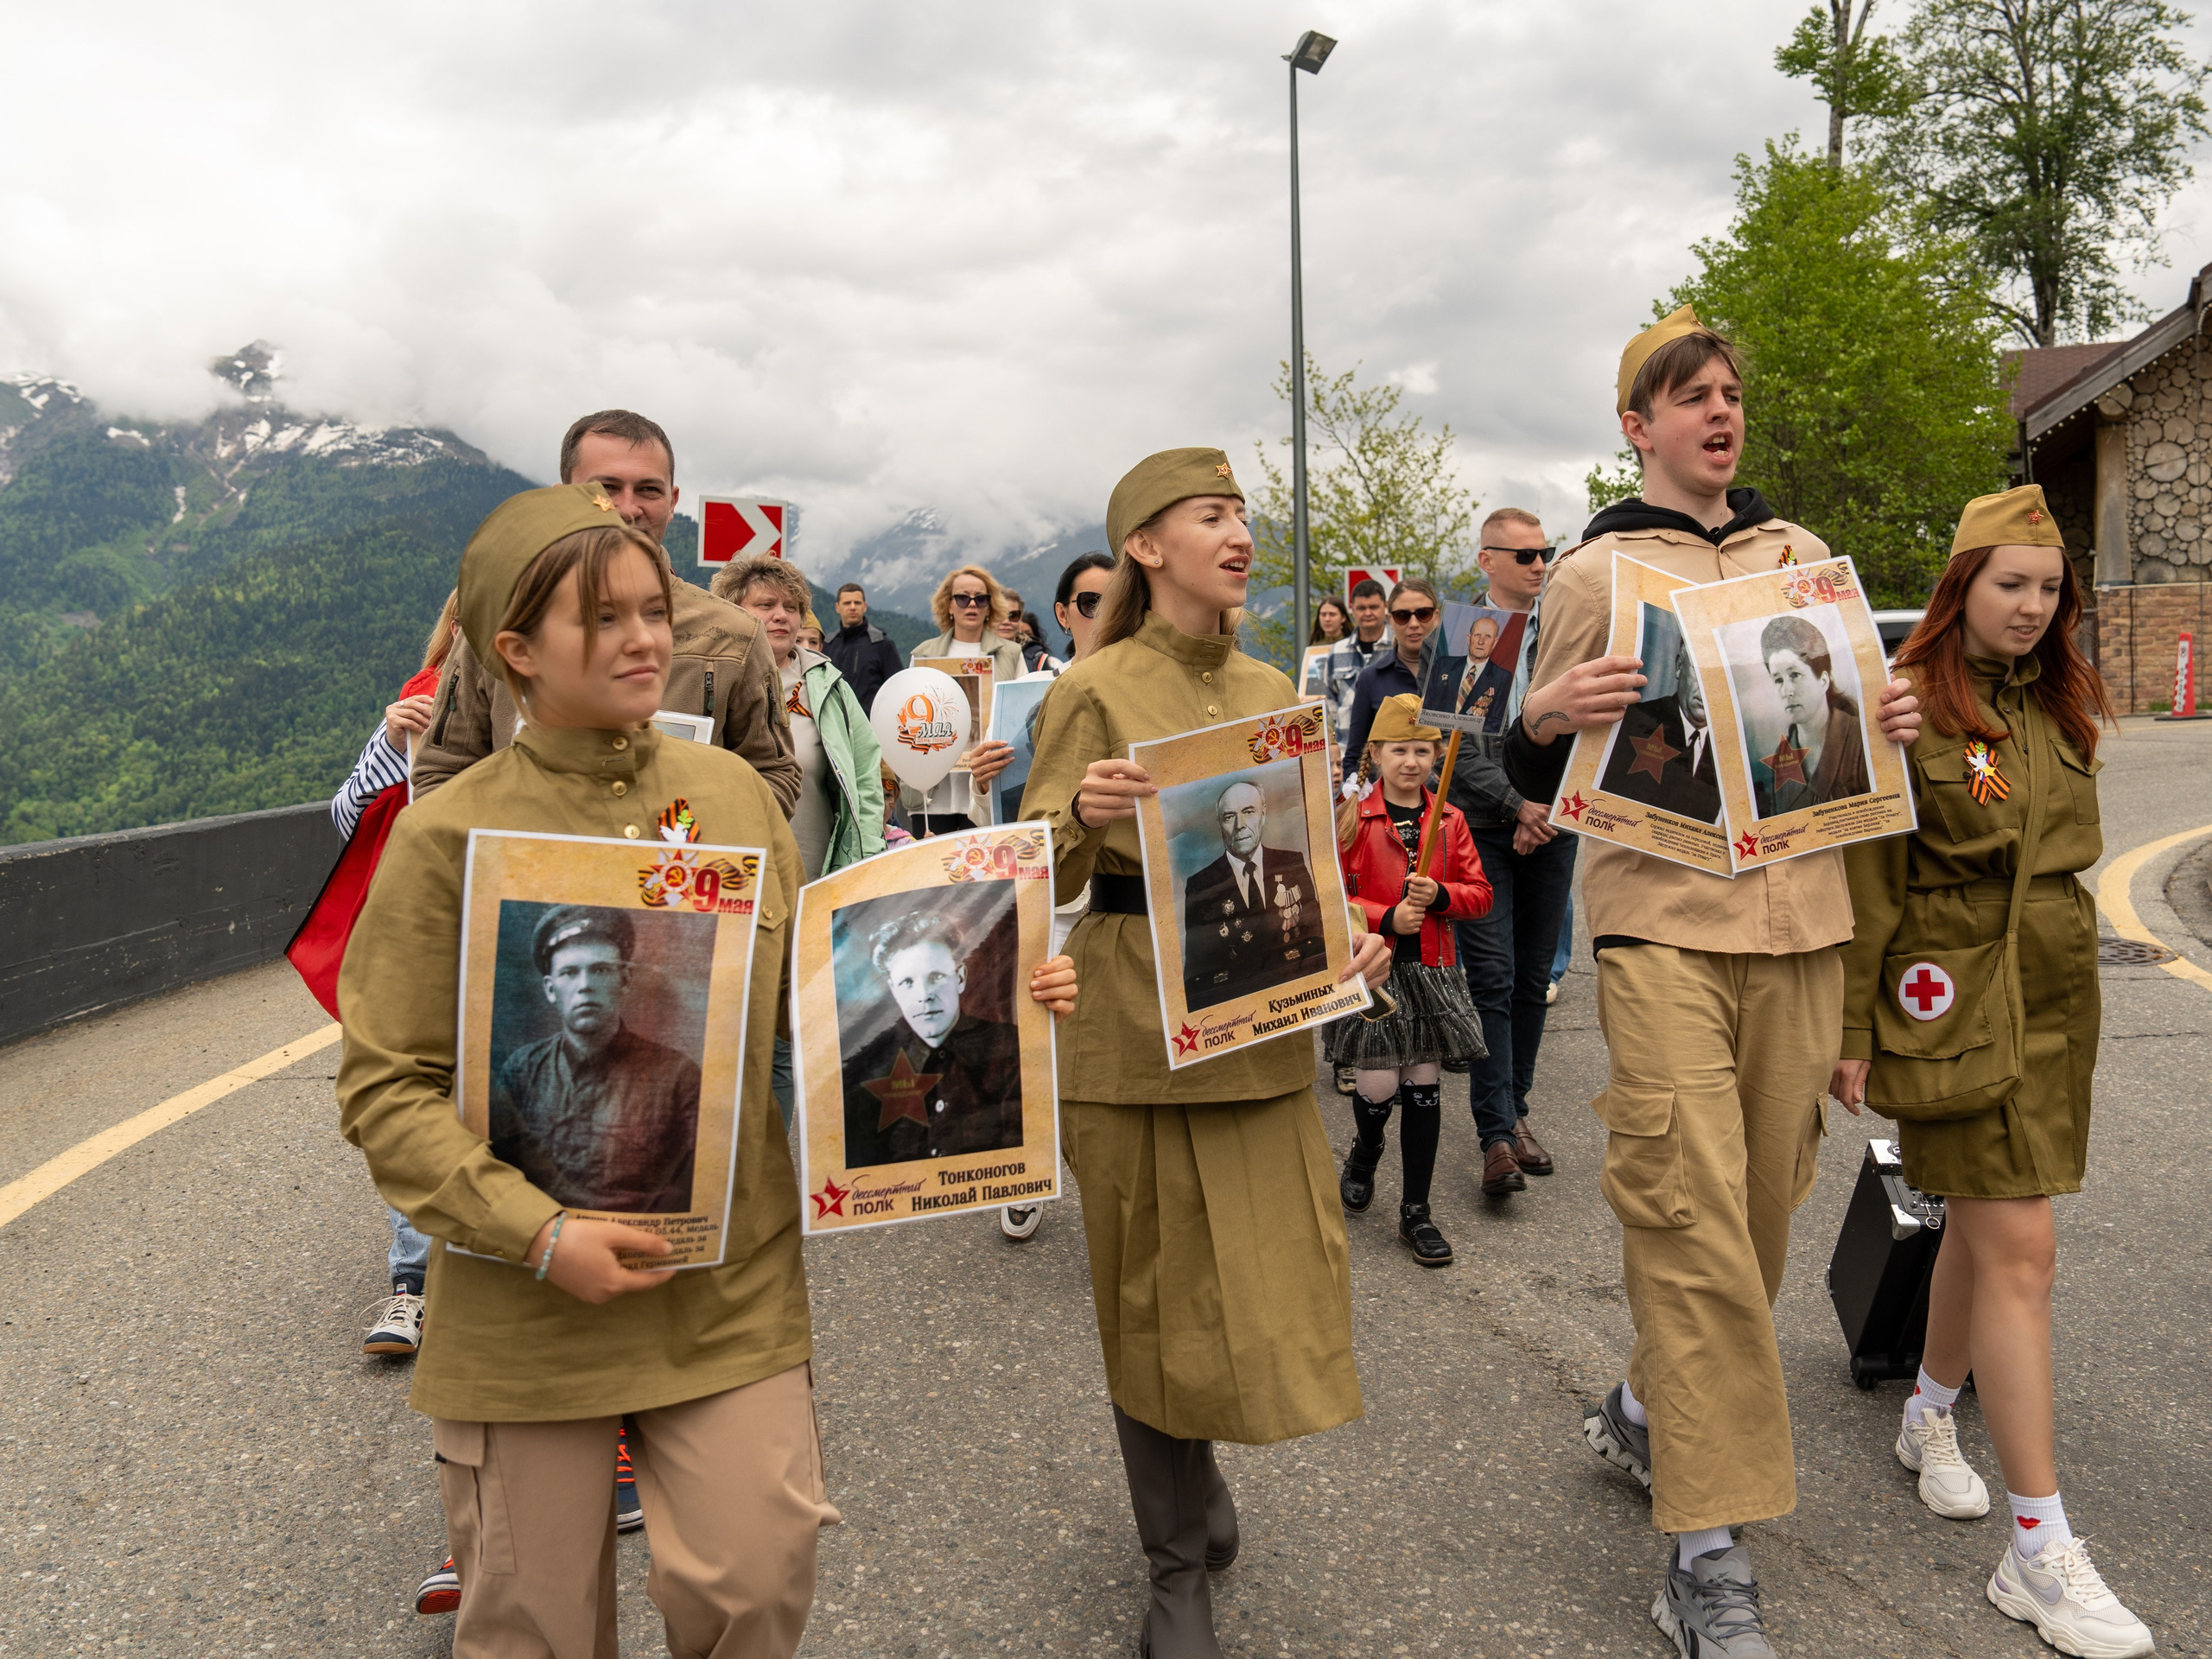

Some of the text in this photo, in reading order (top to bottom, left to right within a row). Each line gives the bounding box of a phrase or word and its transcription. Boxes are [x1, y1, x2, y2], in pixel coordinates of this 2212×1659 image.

[1815, 575, 1837, 603] 9
[1836, 588, 1860, 601] мая
[905, 694, 934, 724] 9
[1452, 714, 1484, 724] Александр
[917, 721, 953, 738] мая
[1418, 717, 1455, 728] Степанович
[1285, 723, 1303, 758] 9
[1303, 738, 1326, 754] мая
[1647, 743, 1662, 754] МЫ
[1779, 753, 1794, 762] МЫ
[1848, 798, 1868, 809] Мария
[1869, 793, 1901, 805] Сергеевна
[1588, 798, 1643, 829] бессмертный
[1585, 816, 1617, 833] ПОЛК
[1679, 820, 1702, 834] Михаил
[1758, 823, 1809, 845] бессмертный
[1763, 839, 1790, 855] ПОЛК
[993, 844, 1018, 879] 9
[1018, 865, 1049, 880] мая
[693, 868, 721, 912] 9
[718, 897, 754, 915] мая
[1268, 982, 1337, 1014] Кузьминых
[1200, 1009, 1258, 1038] бессмертный
[1251, 992, 1363, 1038] Михаил Иванович
[1204, 1030, 1236, 1050] ПОЛК
[892, 1077, 916, 1090] МЫ
[938, 1161, 1027, 1187] Тонконогов
[852, 1173, 928, 1201] бессмертный
[912, 1178, 1052, 1212] Николай Павлович
[853, 1198, 895, 1217] ПОЛК
[664, 1215, 709, 1227] Петрович
